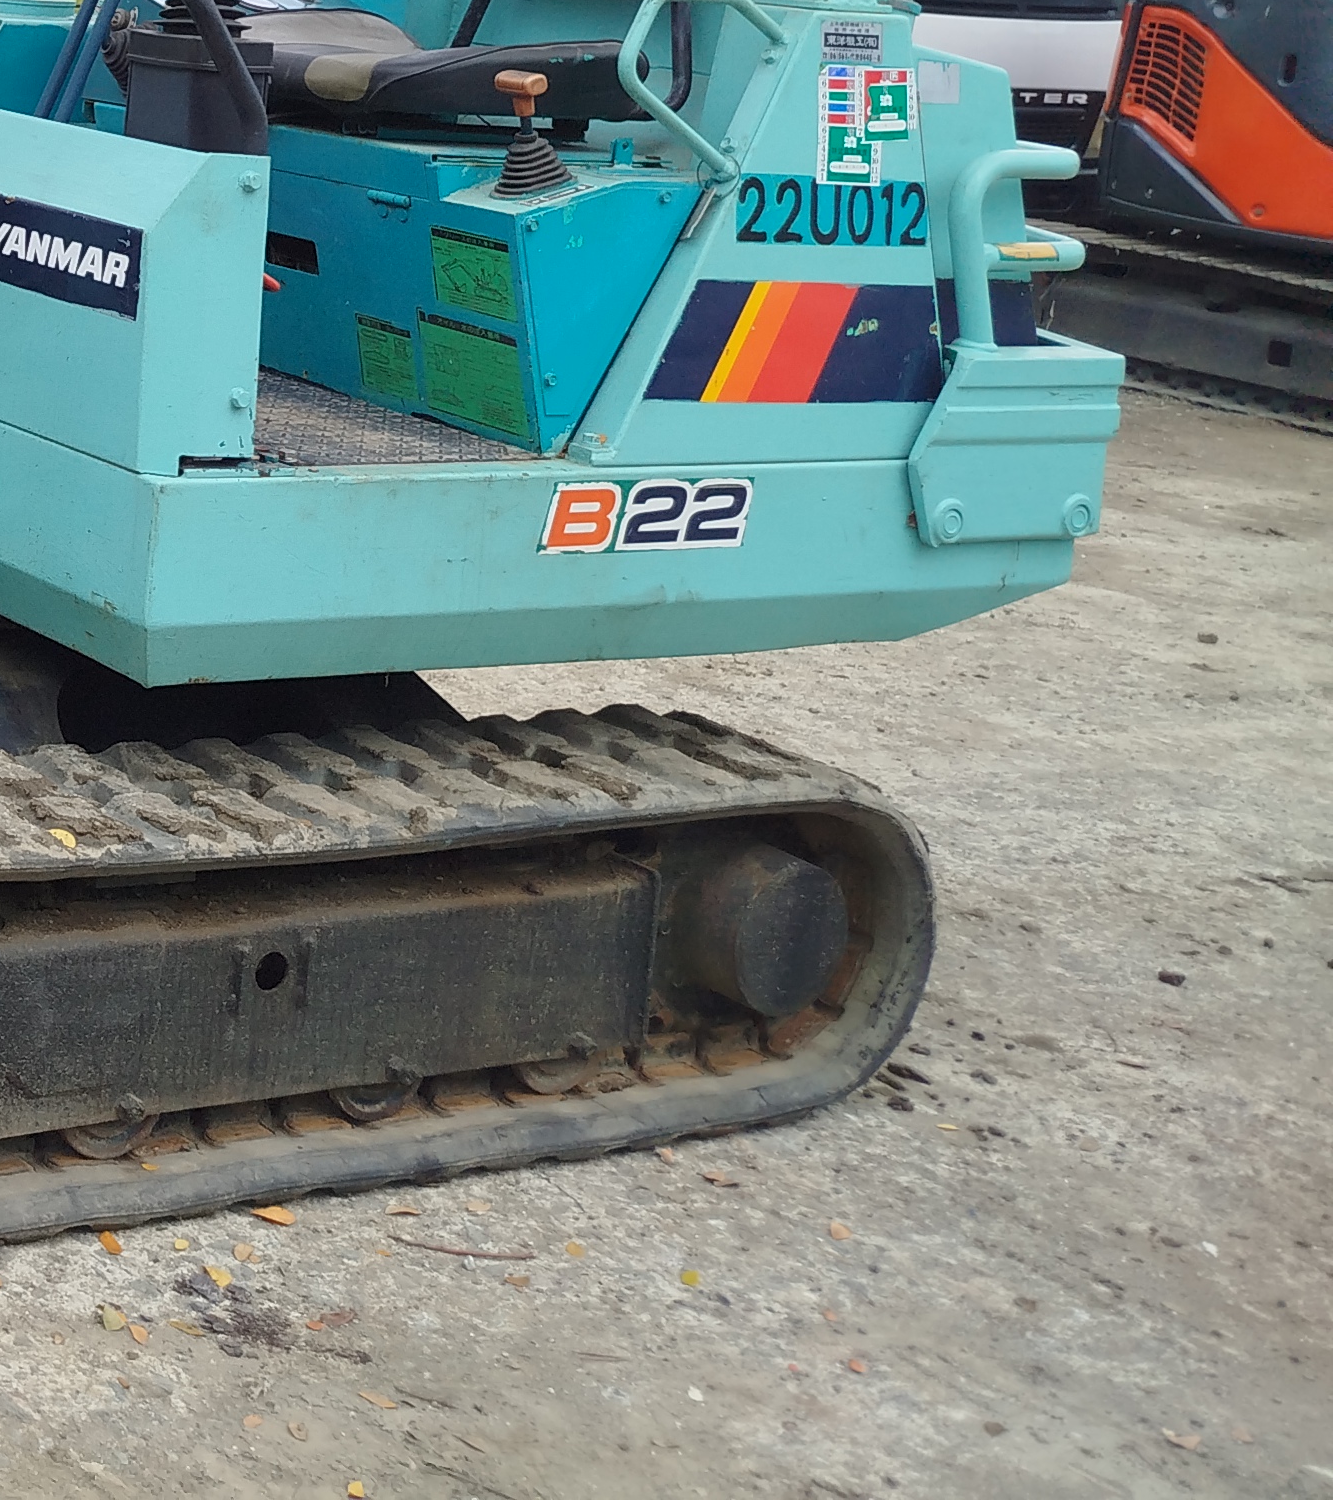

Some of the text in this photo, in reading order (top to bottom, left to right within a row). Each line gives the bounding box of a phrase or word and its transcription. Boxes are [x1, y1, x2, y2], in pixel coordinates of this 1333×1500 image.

[1017, 92, 1088, 105] TER
[736, 177, 926, 246] 22U012
[546, 483, 749, 549] B22
